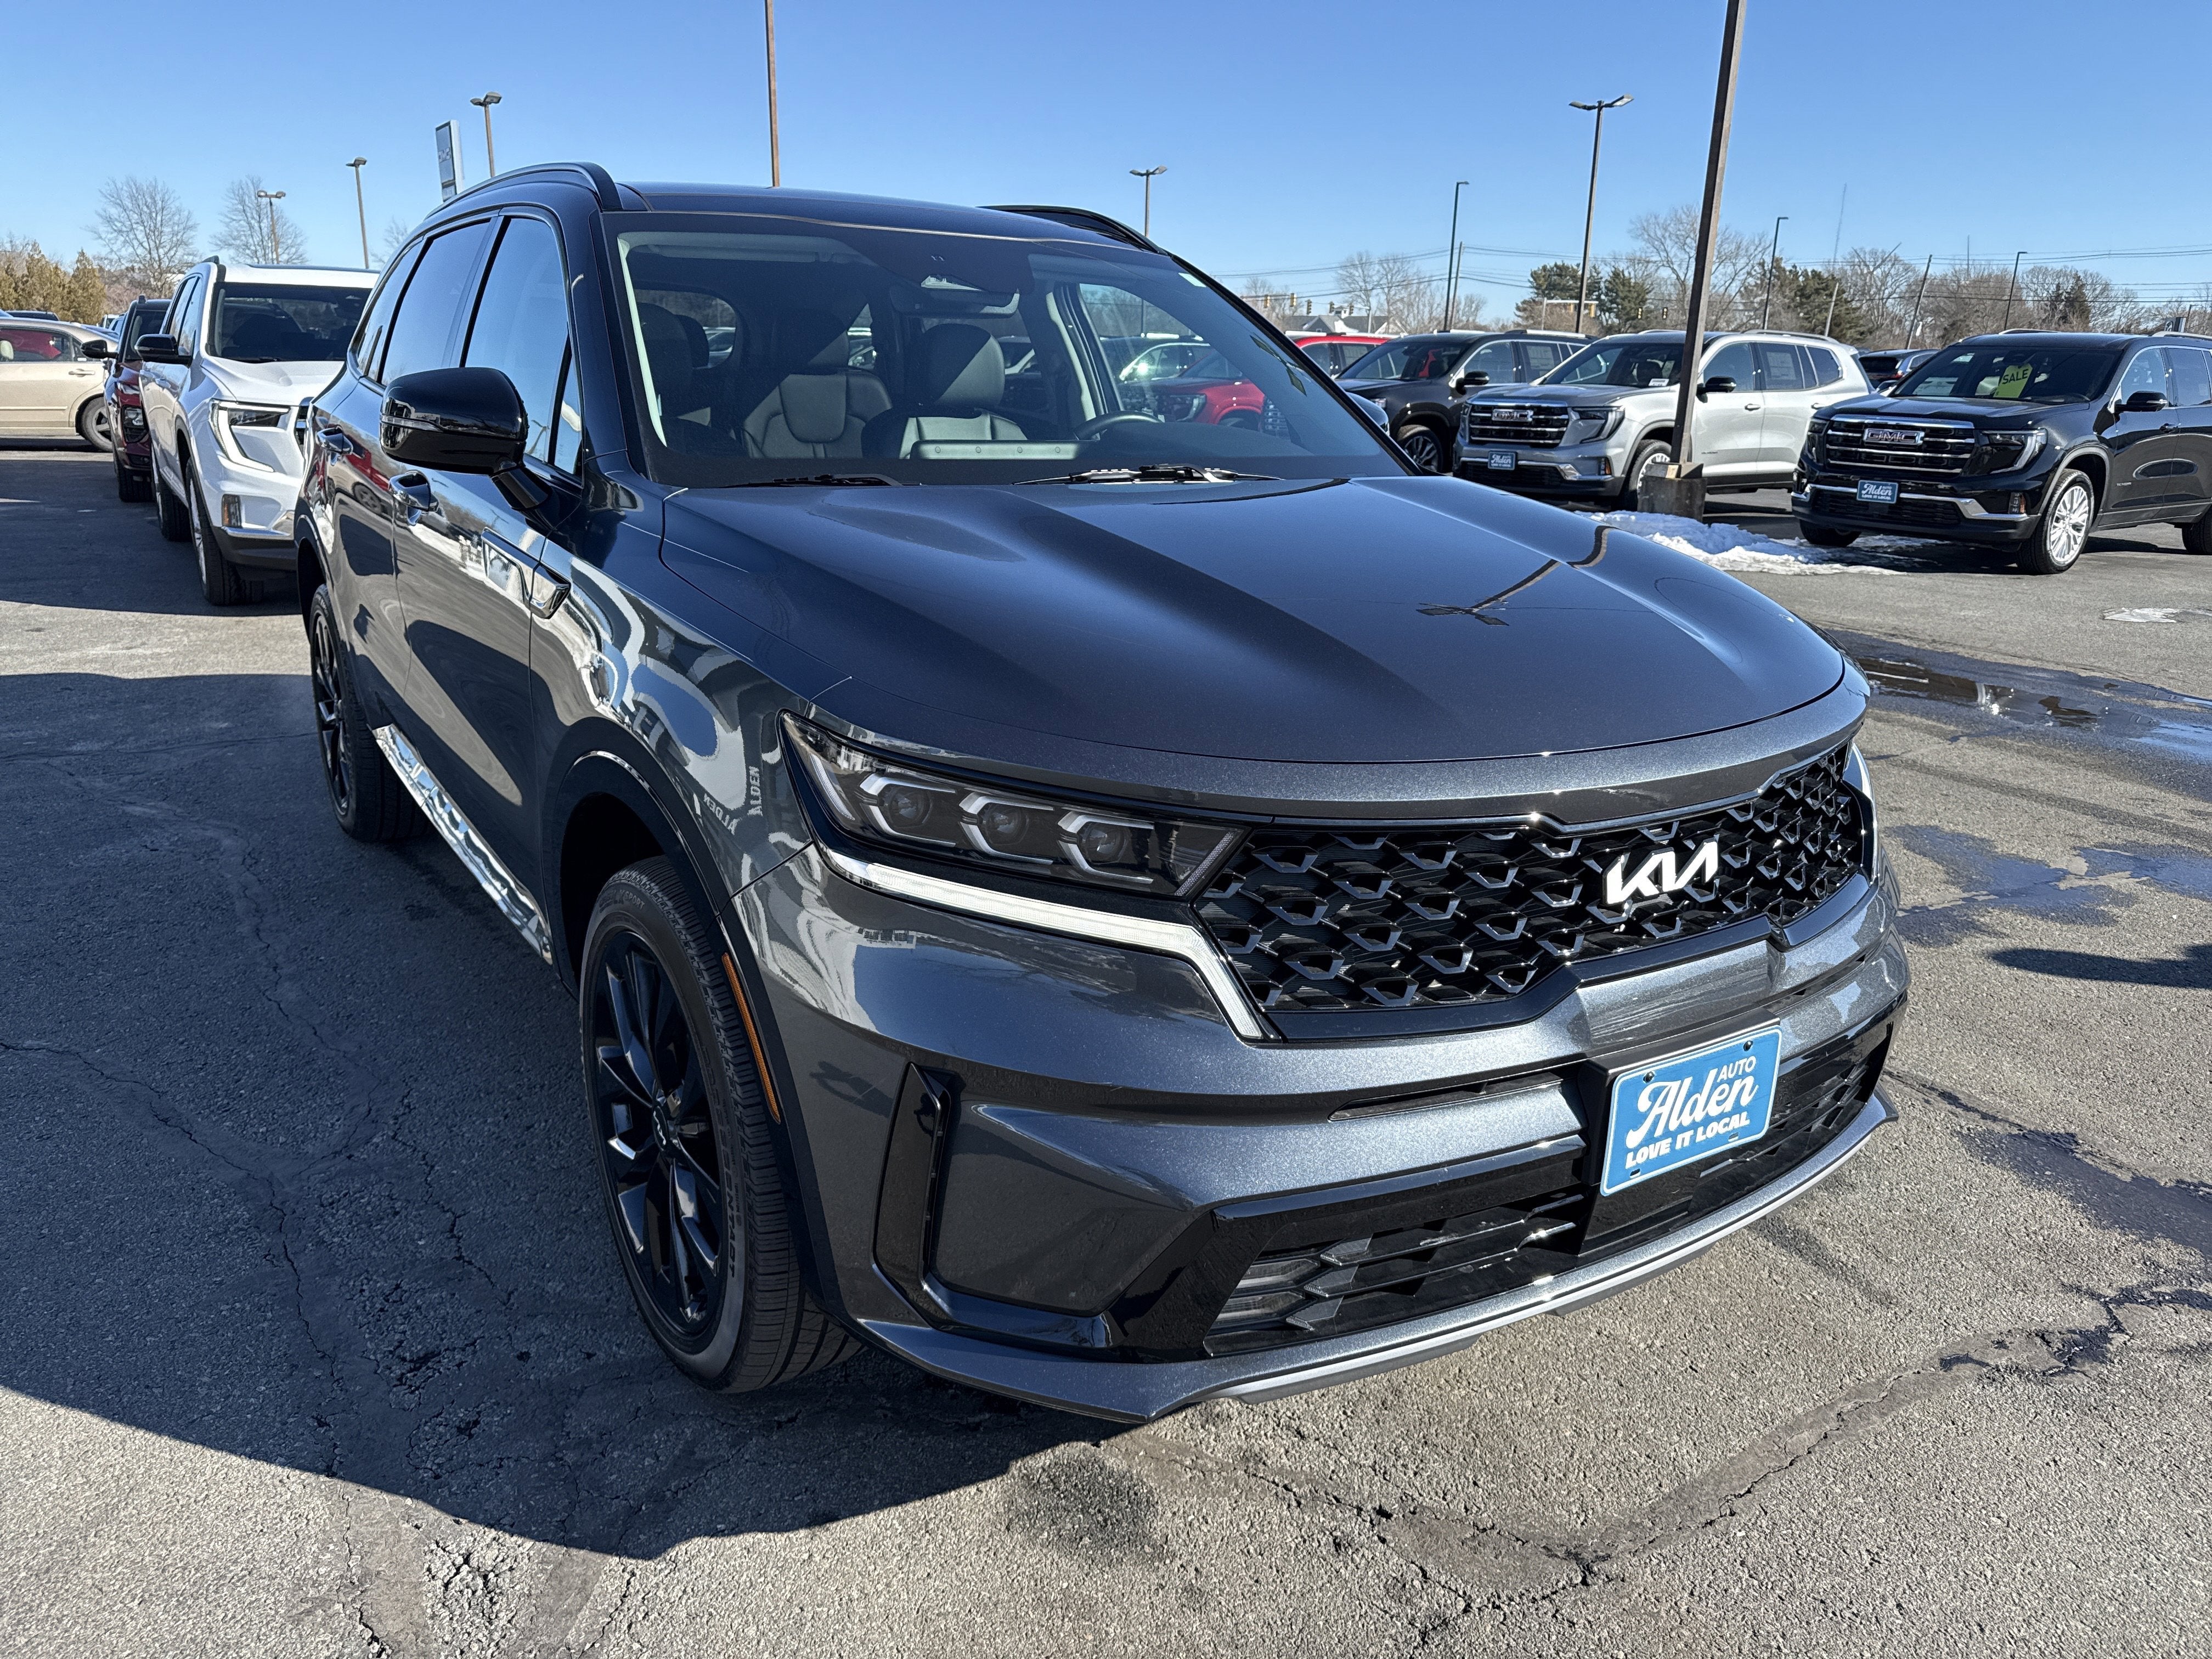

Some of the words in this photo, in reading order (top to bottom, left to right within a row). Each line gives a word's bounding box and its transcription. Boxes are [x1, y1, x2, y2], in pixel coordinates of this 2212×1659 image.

[2001, 368, 2029, 385] SALE
[1867, 429, 1916, 443] GMC
[1861, 483, 1892, 496] Alden
[748, 766, 763, 817] ALDEN
[1605, 839, 1719, 905] KIA
[1717, 1056, 1756, 1082] AUTO
[1626, 1068, 1759, 1149] Alden
[1624, 1137, 1672, 1170] LOVE
[1675, 1130, 1694, 1150] IT
[1695, 1111, 1751, 1143] LOCAL
